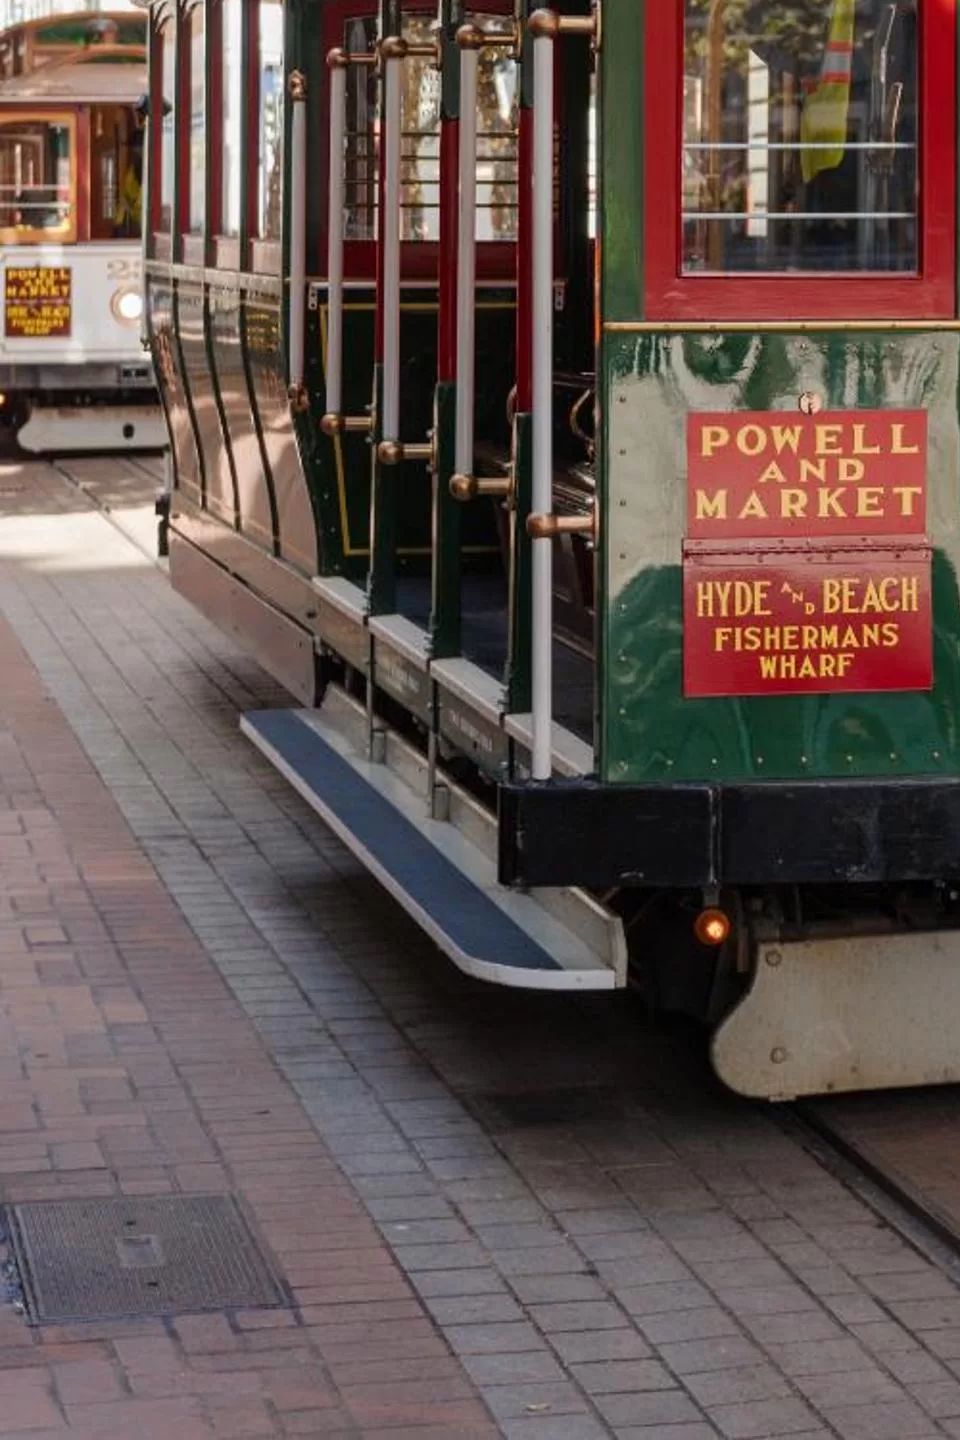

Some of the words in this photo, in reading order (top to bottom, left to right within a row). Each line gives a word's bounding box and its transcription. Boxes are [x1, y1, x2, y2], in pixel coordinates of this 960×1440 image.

[700, 423, 920, 457] POWELL
[758, 458, 865, 483] AND
[694, 486, 922, 520] MARKET
[696, 580, 773, 617] HYDE
[780, 581, 815, 616] AND
[823, 576, 919, 614] BEACH
[713, 623, 900, 652] FISHERMANS
[759, 653, 855, 679] WHARF
